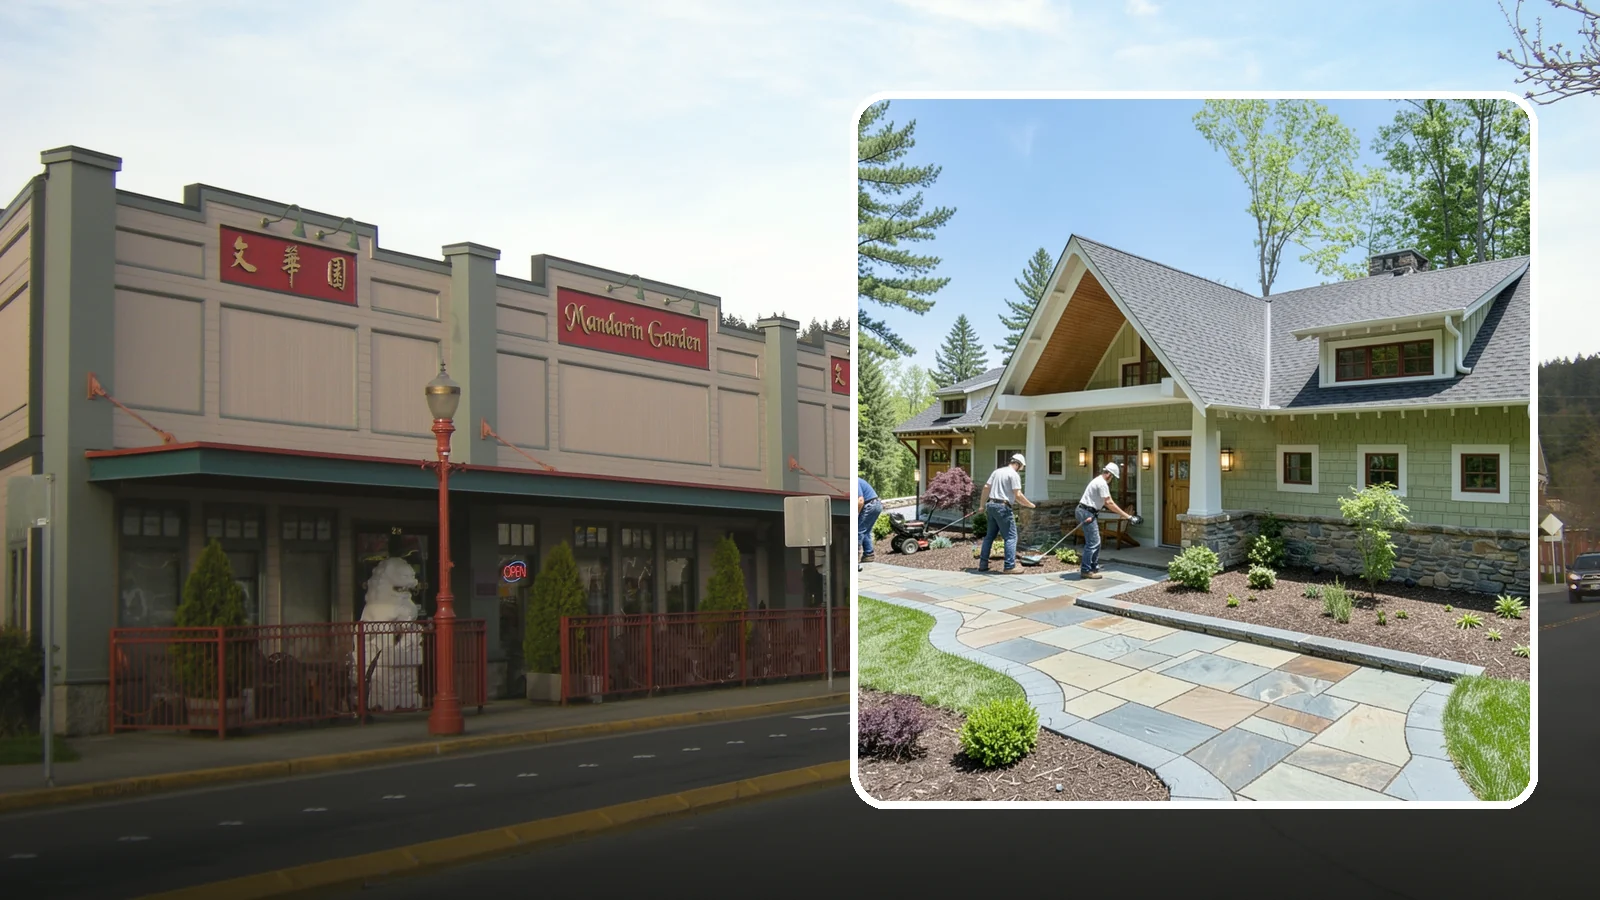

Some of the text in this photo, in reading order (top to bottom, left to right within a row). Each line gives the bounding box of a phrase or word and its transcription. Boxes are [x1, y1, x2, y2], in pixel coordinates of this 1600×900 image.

[231, 236, 346, 290] 文華園
[564, 302, 701, 352] Mandarin Garden
[503, 565, 527, 578] OPEN
